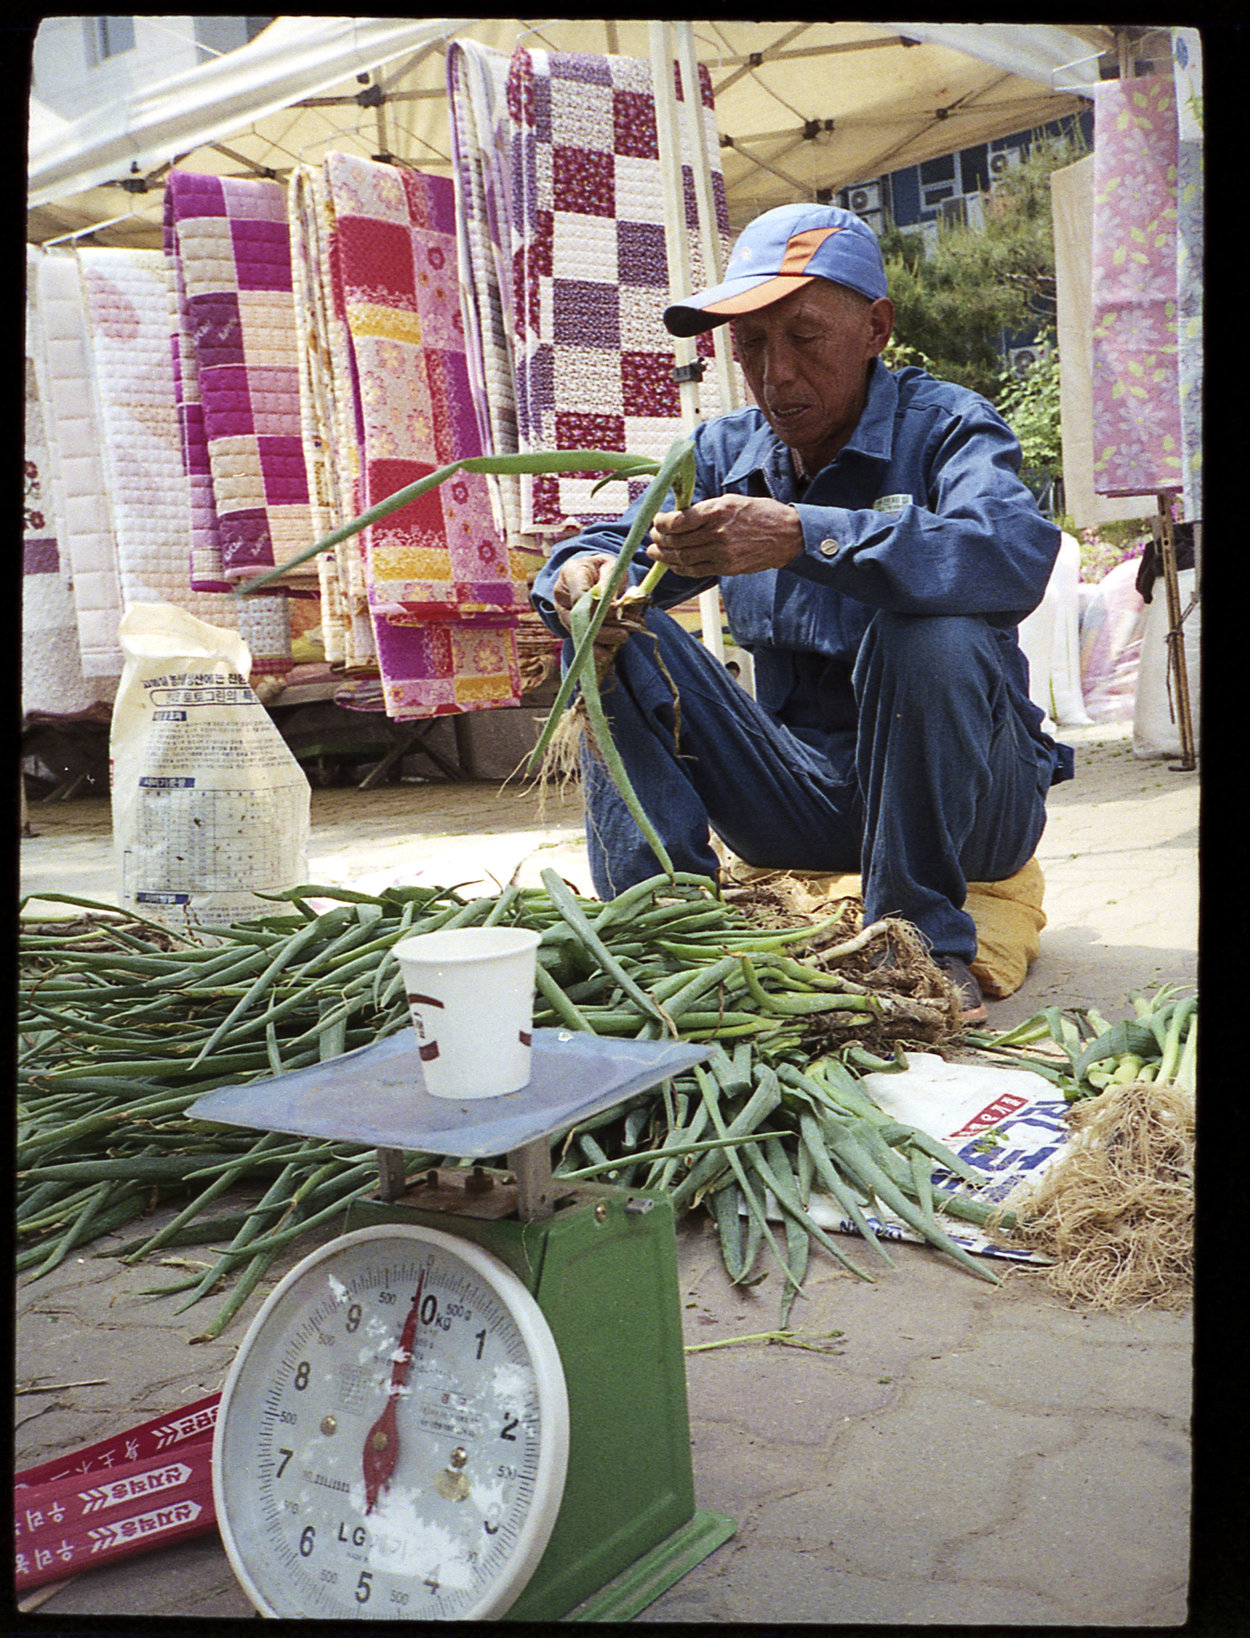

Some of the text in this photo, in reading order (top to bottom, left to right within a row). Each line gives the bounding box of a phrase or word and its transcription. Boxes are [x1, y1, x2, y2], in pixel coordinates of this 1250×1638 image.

[345, 1304, 363, 1333] 9
[475, 1328, 487, 1360] 1
[294, 1361, 311, 1391] 8
[500, 1411, 519, 1441] 2
[276, 1449, 294, 1479] 7
[15, 1466, 181, 1536] 산지직송 우리
[120, 1503, 193, 1538] 산지직송
[338, 1522, 367, 1547] LG
[299, 1525, 316, 1557] 6
[355, 1571, 374, 1604] 5
